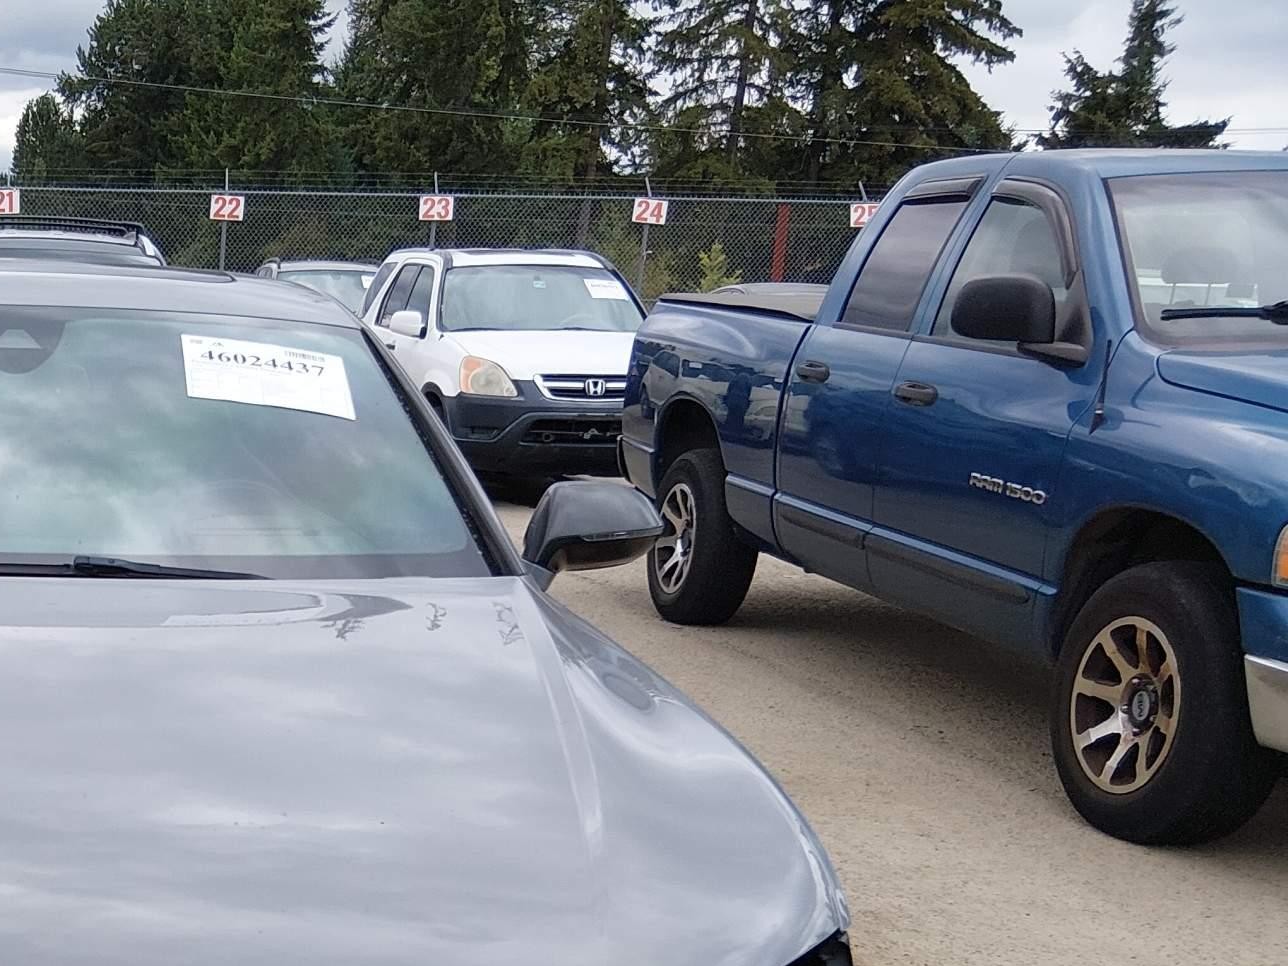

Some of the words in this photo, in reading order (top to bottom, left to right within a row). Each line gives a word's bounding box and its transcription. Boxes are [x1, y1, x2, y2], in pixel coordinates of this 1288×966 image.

[212, 196, 241, 219] 22
[422, 197, 450, 219] 23
[634, 200, 664, 223] 24
[200, 350, 325, 377] 46024437
[968, 472, 1004, 494] RAM
[1006, 482, 1047, 505] 1500
